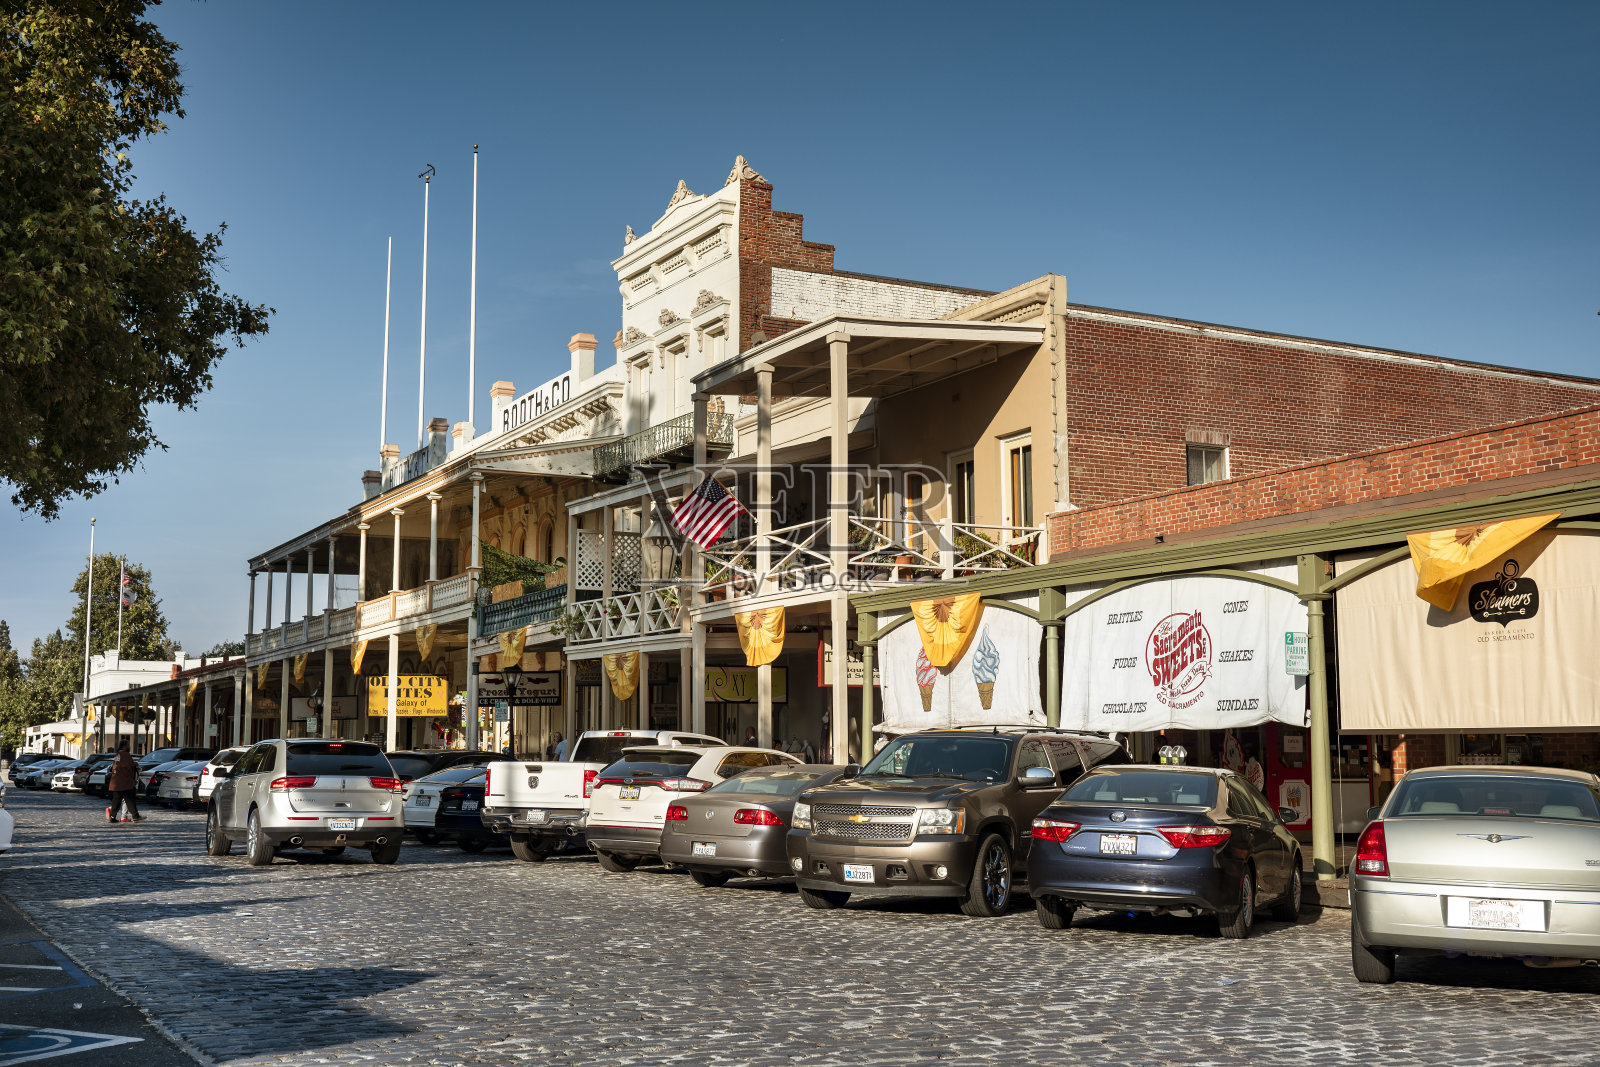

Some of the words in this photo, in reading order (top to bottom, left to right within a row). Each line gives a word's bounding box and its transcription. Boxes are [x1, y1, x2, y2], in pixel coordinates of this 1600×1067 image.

[1474, 588, 1533, 610] Steamers
[1223, 600, 1249, 614] CONES
[1107, 610, 1143, 625] BRITTLES
[1153, 609, 1201, 656] Sacramento
[1286, 633, 1292, 644] 2
[1492, 632, 1535, 642] SACRAMENTO
[1218, 649, 1254, 662] SHAKES
[1286, 646, 1306, 655] PARKING
[1112, 657, 1137, 669] FUDGE
[1153, 629, 1203, 687] SWEETS
[408, 676, 443, 687] CITY
[518, 687, 557, 698] Yogurt
[396, 699, 418, 707] Galaxy
[1156, 692, 1167, 704] OLD
[1168, 690, 1204, 710] SACRAMENTO
[1216, 698, 1259, 712] SUNDAES
[1102, 701, 1147, 714] CHOCOLATES
